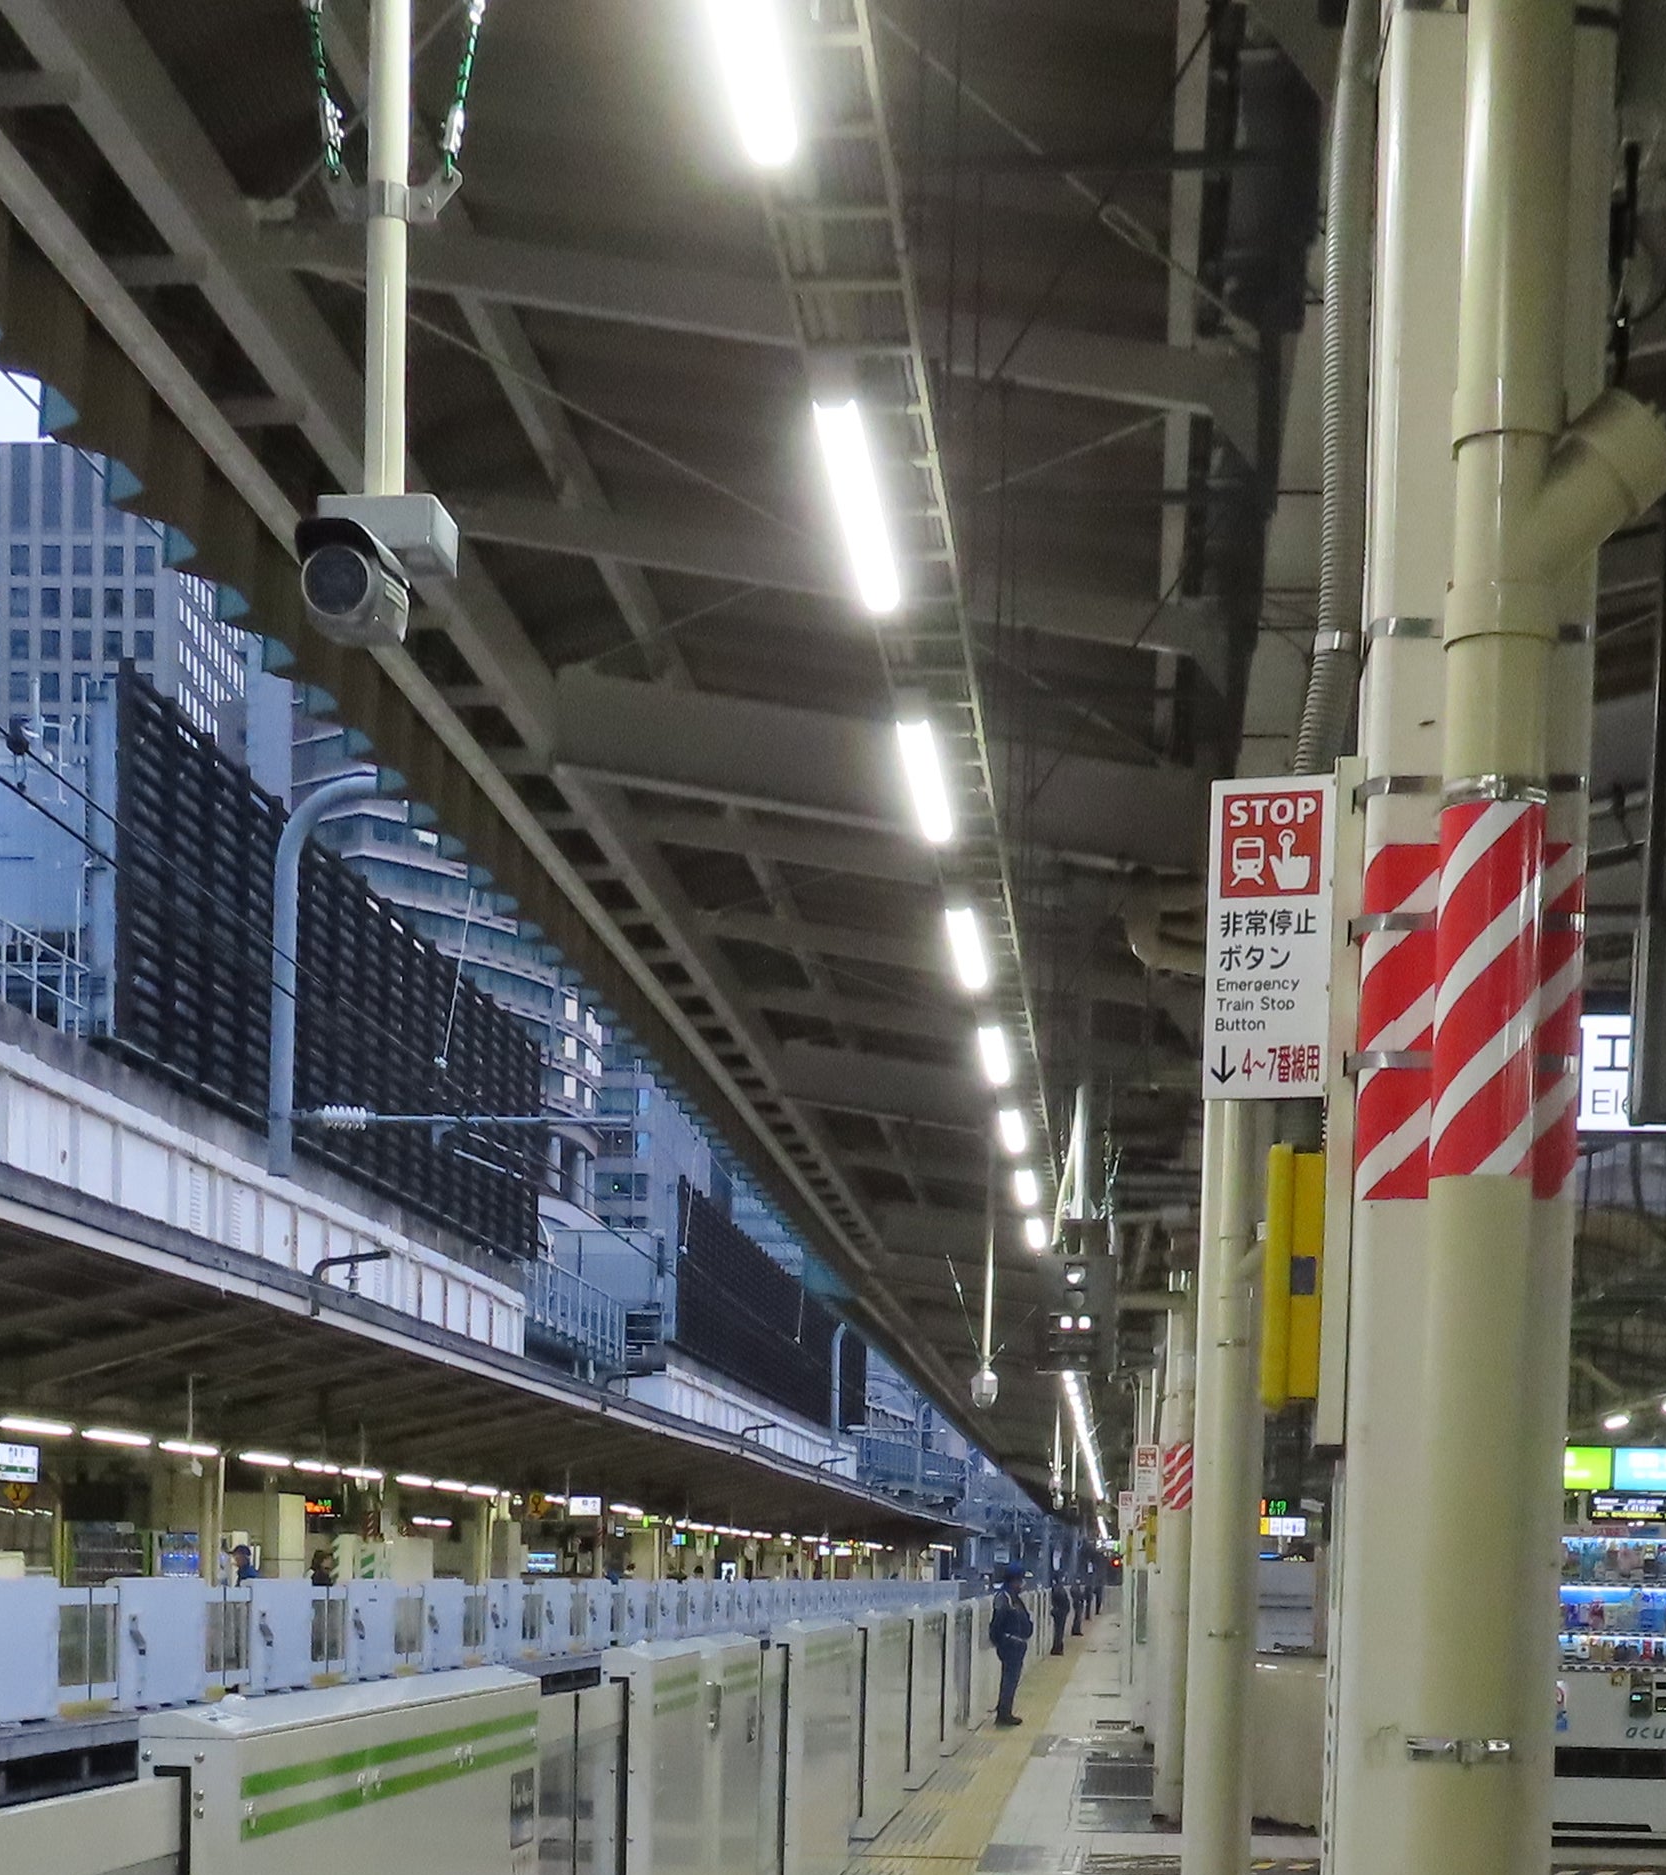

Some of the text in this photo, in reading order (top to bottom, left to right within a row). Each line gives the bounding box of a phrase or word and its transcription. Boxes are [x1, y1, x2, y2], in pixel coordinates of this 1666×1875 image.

[1229, 797, 1318, 828] STOP
[1220, 908, 1317, 938] 非常停止
[1219, 944, 1290, 971] ボタン
[1216, 978, 1300, 992] Emergency
[1217, 996, 1295, 1012] Train Stop
[1215, 1017, 1266, 1032] Button
